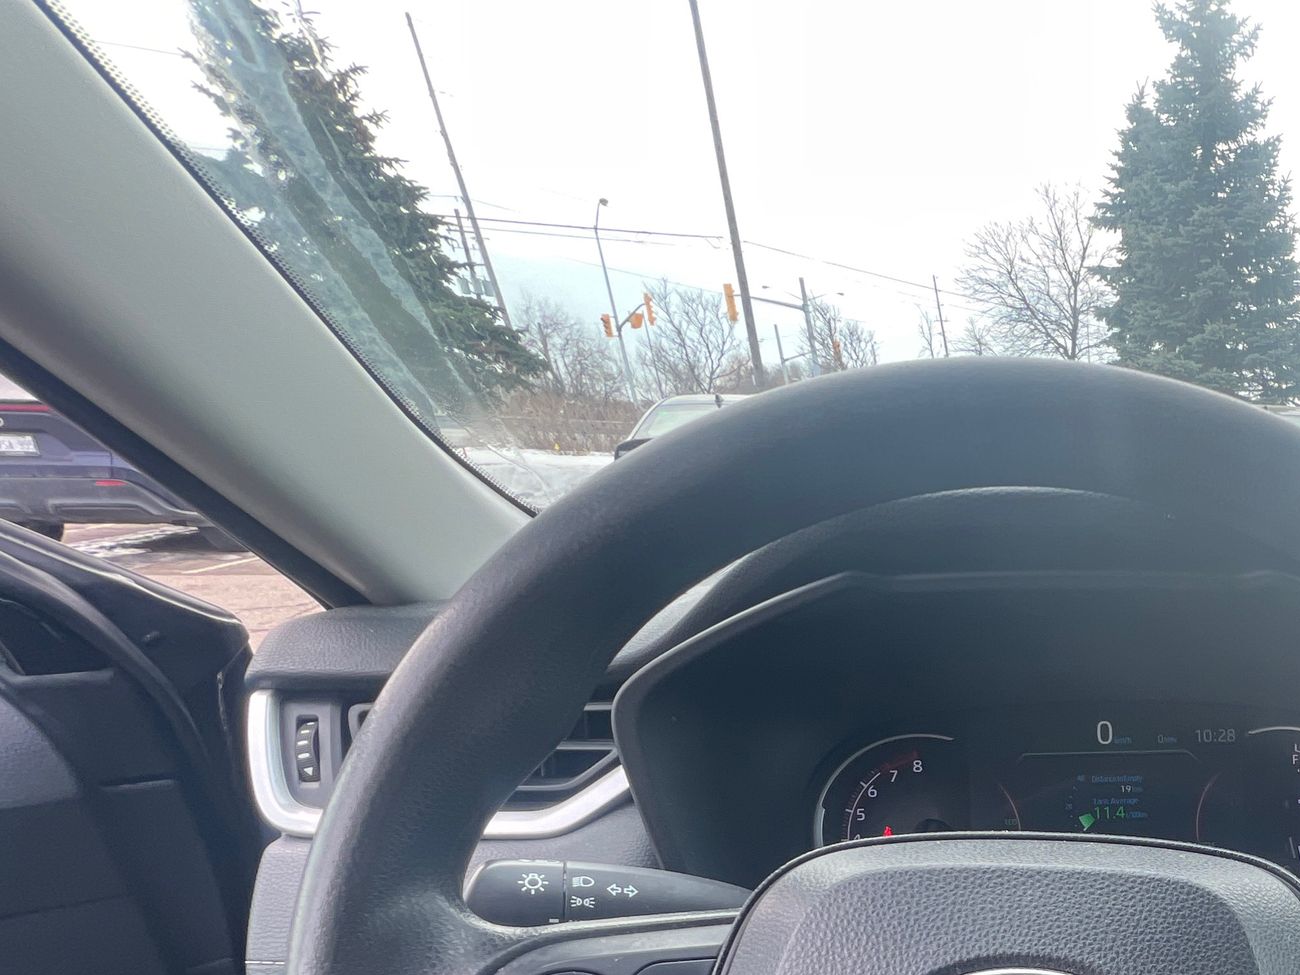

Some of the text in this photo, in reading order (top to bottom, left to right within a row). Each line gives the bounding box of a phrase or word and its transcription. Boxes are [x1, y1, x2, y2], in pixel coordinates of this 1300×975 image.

[1097, 721, 1113, 744] 0
[1195, 729, 1235, 743] 10:28
[1292, 754, 1299, 765] F
[912, 760, 923, 773] 8
[889, 770, 898, 782] 7
[867, 785, 877, 798] 6
[1121, 785, 1131, 793] 19
[856, 808, 866, 821] 5
[1094, 806, 1126, 820] 11.4
